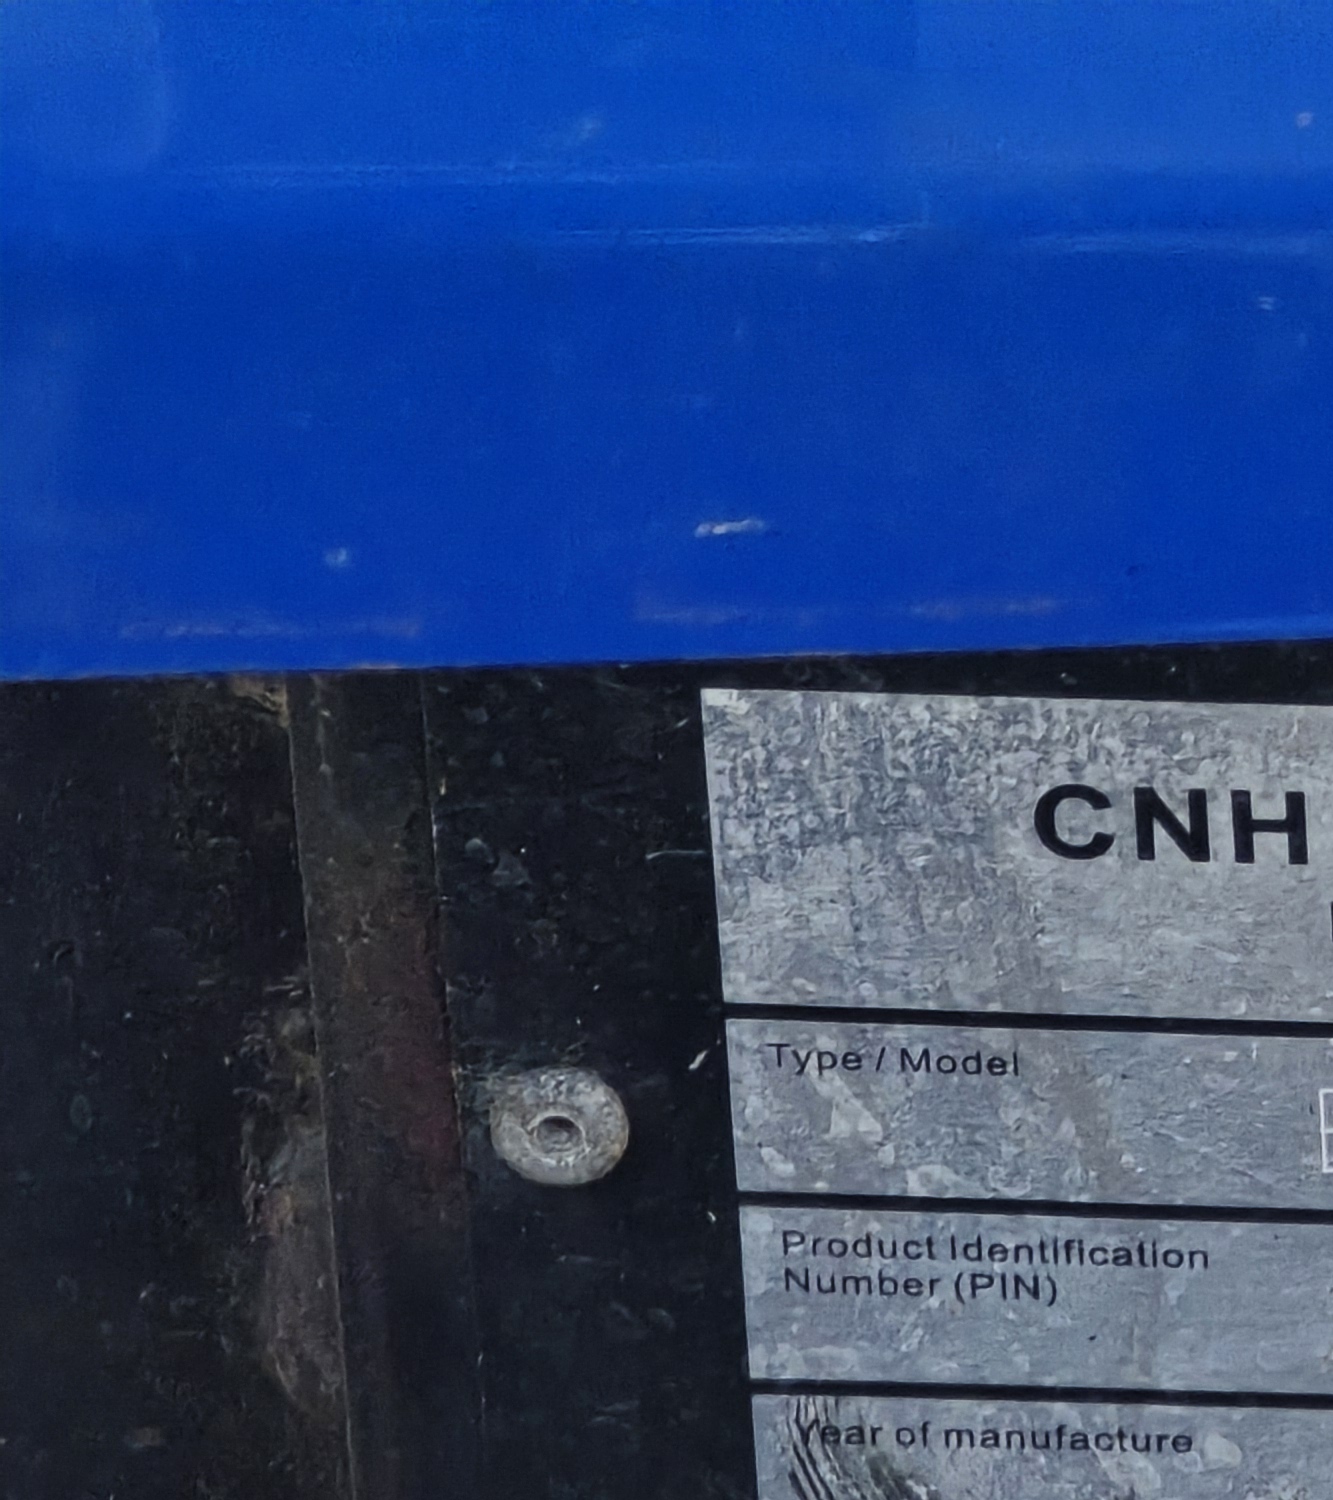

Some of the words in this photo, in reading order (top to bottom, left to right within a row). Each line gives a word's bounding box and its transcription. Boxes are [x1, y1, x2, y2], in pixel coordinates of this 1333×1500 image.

[1033, 783, 1309, 866] CNH
[766, 1042, 863, 1076] Type
[875, 1046, 887, 1072] /
[899, 1047, 1019, 1076] Model
[781, 1229, 937, 1262] Product
[949, 1233, 1210, 1271] Identification
[783, 1266, 942, 1297] Number
[953, 1271, 1058, 1307] (PIN)
[797, 1418, 883, 1447] Year
[894, 1420, 932, 1448] of
[943, 1423, 1194, 1453] manufacture
